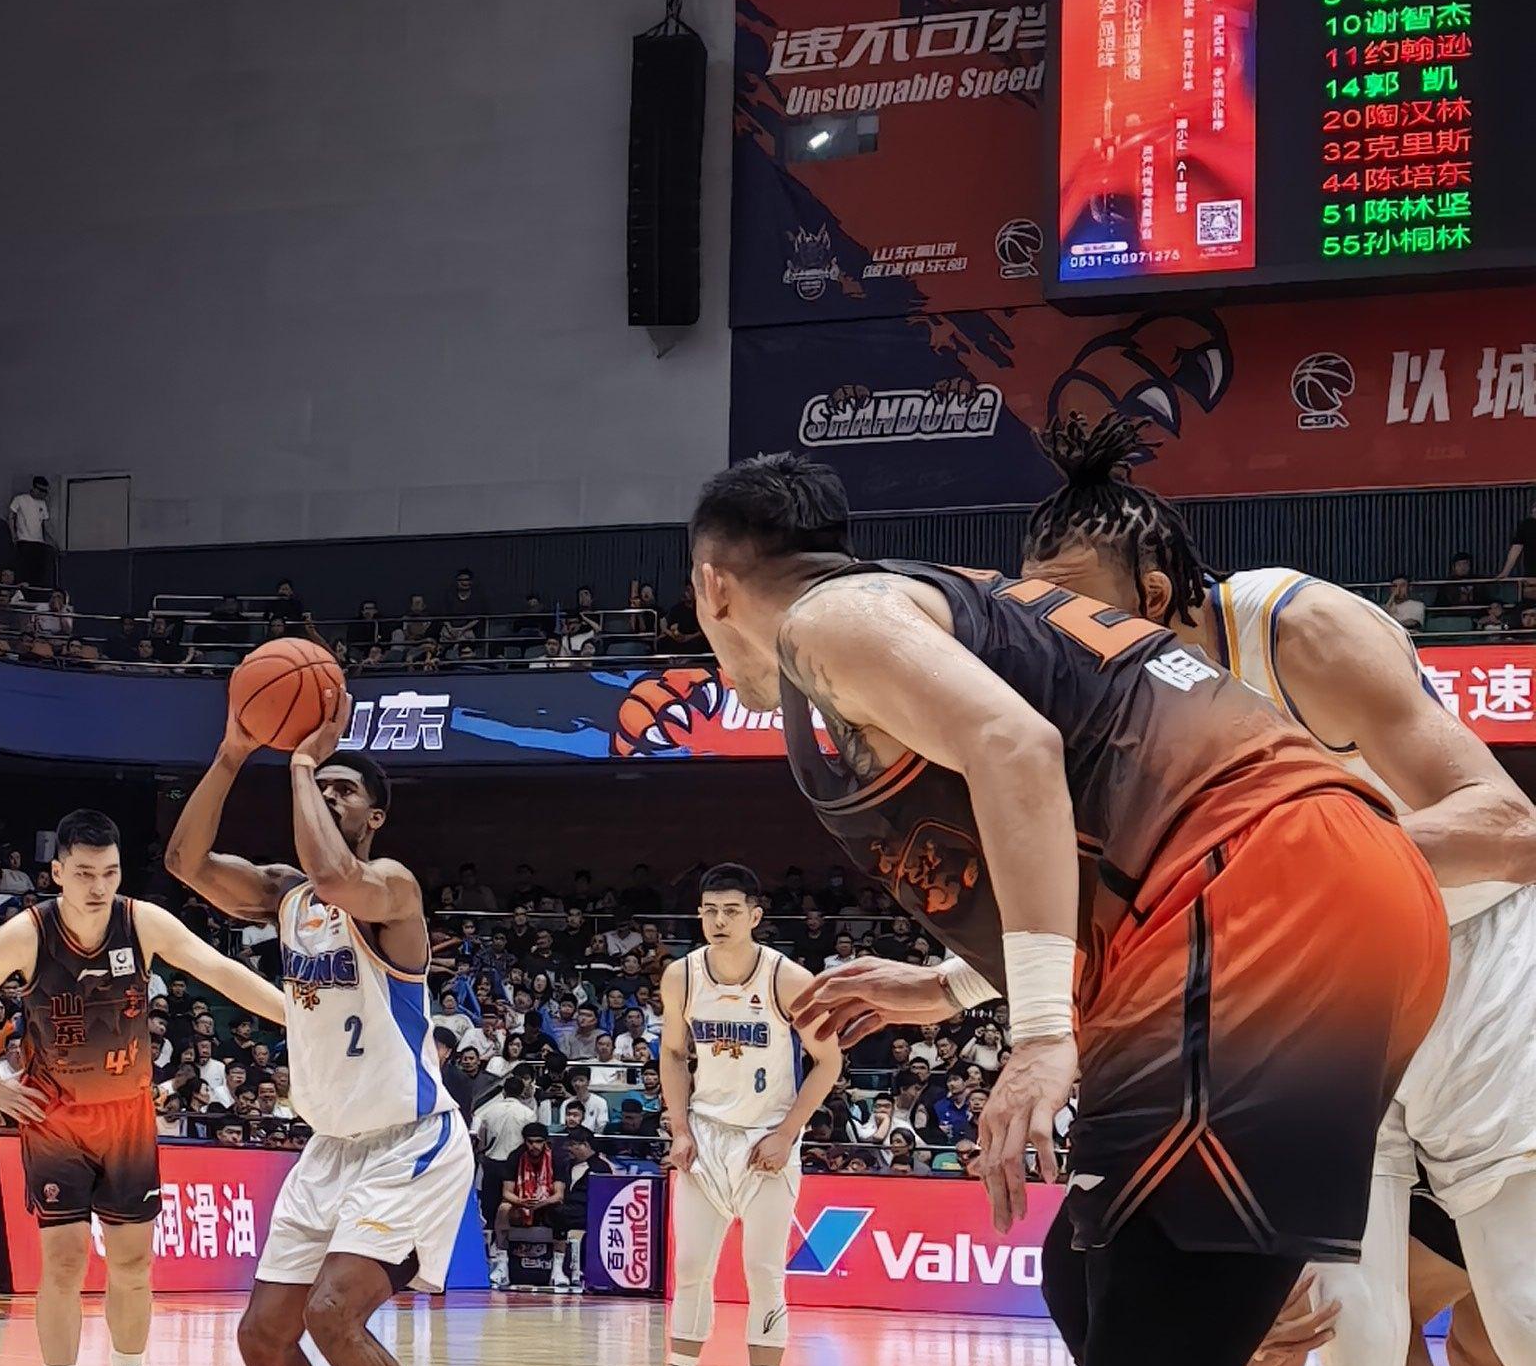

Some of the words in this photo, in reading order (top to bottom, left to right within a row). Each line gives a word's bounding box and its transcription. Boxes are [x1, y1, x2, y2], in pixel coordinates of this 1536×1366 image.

[765, 2, 1046, 77] 速不可挡
[785, 71, 953, 116] Unstoppable
[957, 60, 1045, 99] Speed
[804, 388, 998, 441] SHANDONG
[344, 1014, 365, 1057] 2
[691, 1019, 771, 1047] BEIJING
[754, 1067, 767, 1094] 8
